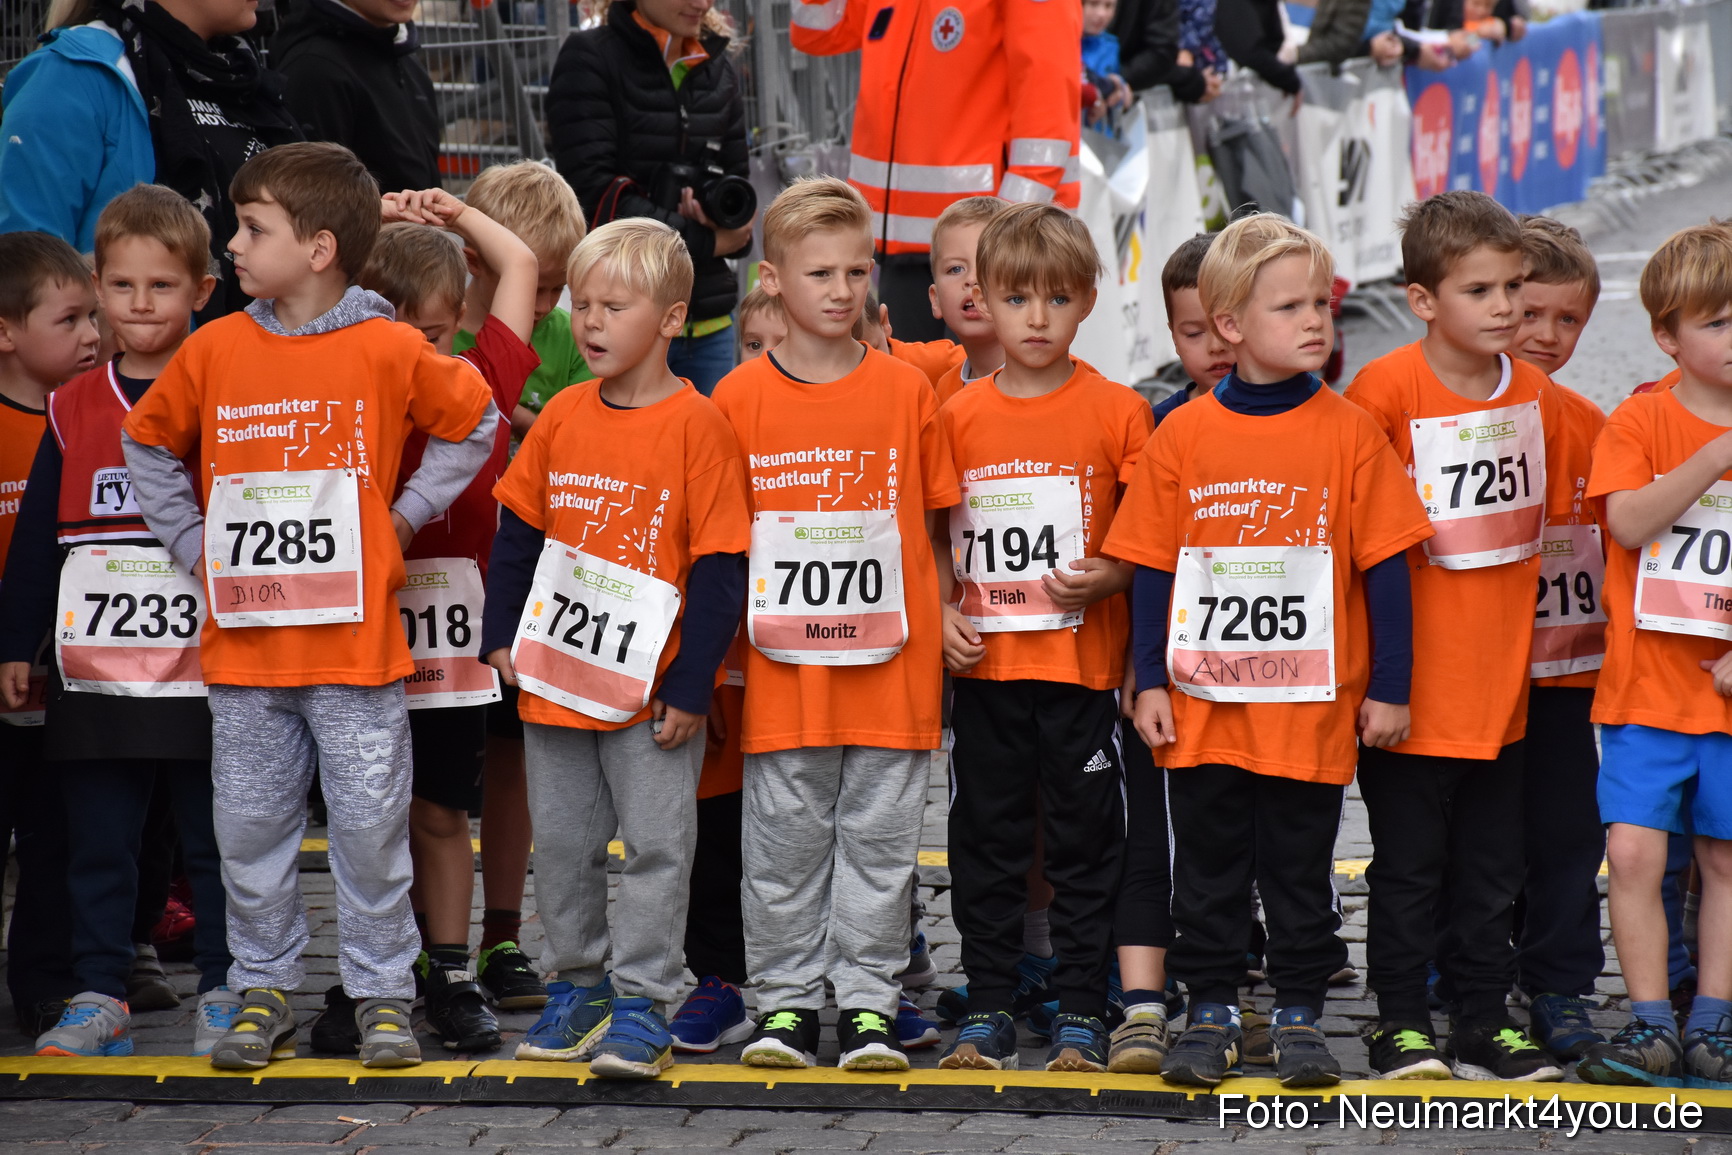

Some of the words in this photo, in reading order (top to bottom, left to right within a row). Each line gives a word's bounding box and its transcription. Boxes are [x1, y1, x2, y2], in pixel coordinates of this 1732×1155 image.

[217, 398, 319, 421] Neumarkter
[217, 420, 298, 444] Stadtlauf
[1475, 420, 1516, 439] BOCK
[355, 400, 370, 489] BAMBINI
[749, 447, 854, 469] Neumarkter
[752, 468, 833, 492] Stadtlauf
[963, 458, 1053, 483] Neumarkter
[1441, 452, 1531, 509] 7251
[95, 481, 138, 512] ry
[256, 485, 312, 500] BOCK
[981, 492, 1034, 508] BOCK
[226, 518, 336, 567] 7285
[810, 526, 864, 540] BOCK
[962, 524, 1060, 573] 7194
[1540, 540, 1575, 554] OCK
[1671, 525, 1732, 576] 70
[121, 560, 177, 573] BOCK
[1229, 561, 1286, 575] BOCK
[1646, 562, 1659, 572] B2
[583, 569, 636, 599] BOCK
[774, 558, 883, 606] 7070
[230, 582, 286, 606] DIOR
[755, 599, 767, 608] B2
[989, 589, 1026, 605] Eliah
[84, 592, 198, 639] 7233
[1198, 595, 1307, 642] 7265
[62, 632, 76, 640] B2
[547, 591, 638, 665] 7211
[805, 623, 857, 639] Moritz
[1177, 633, 1188, 643] B2
[405, 667, 445, 684] obias
[1189, 657, 1299, 684] ANTON
[1083, 760, 1112, 773] adidas
